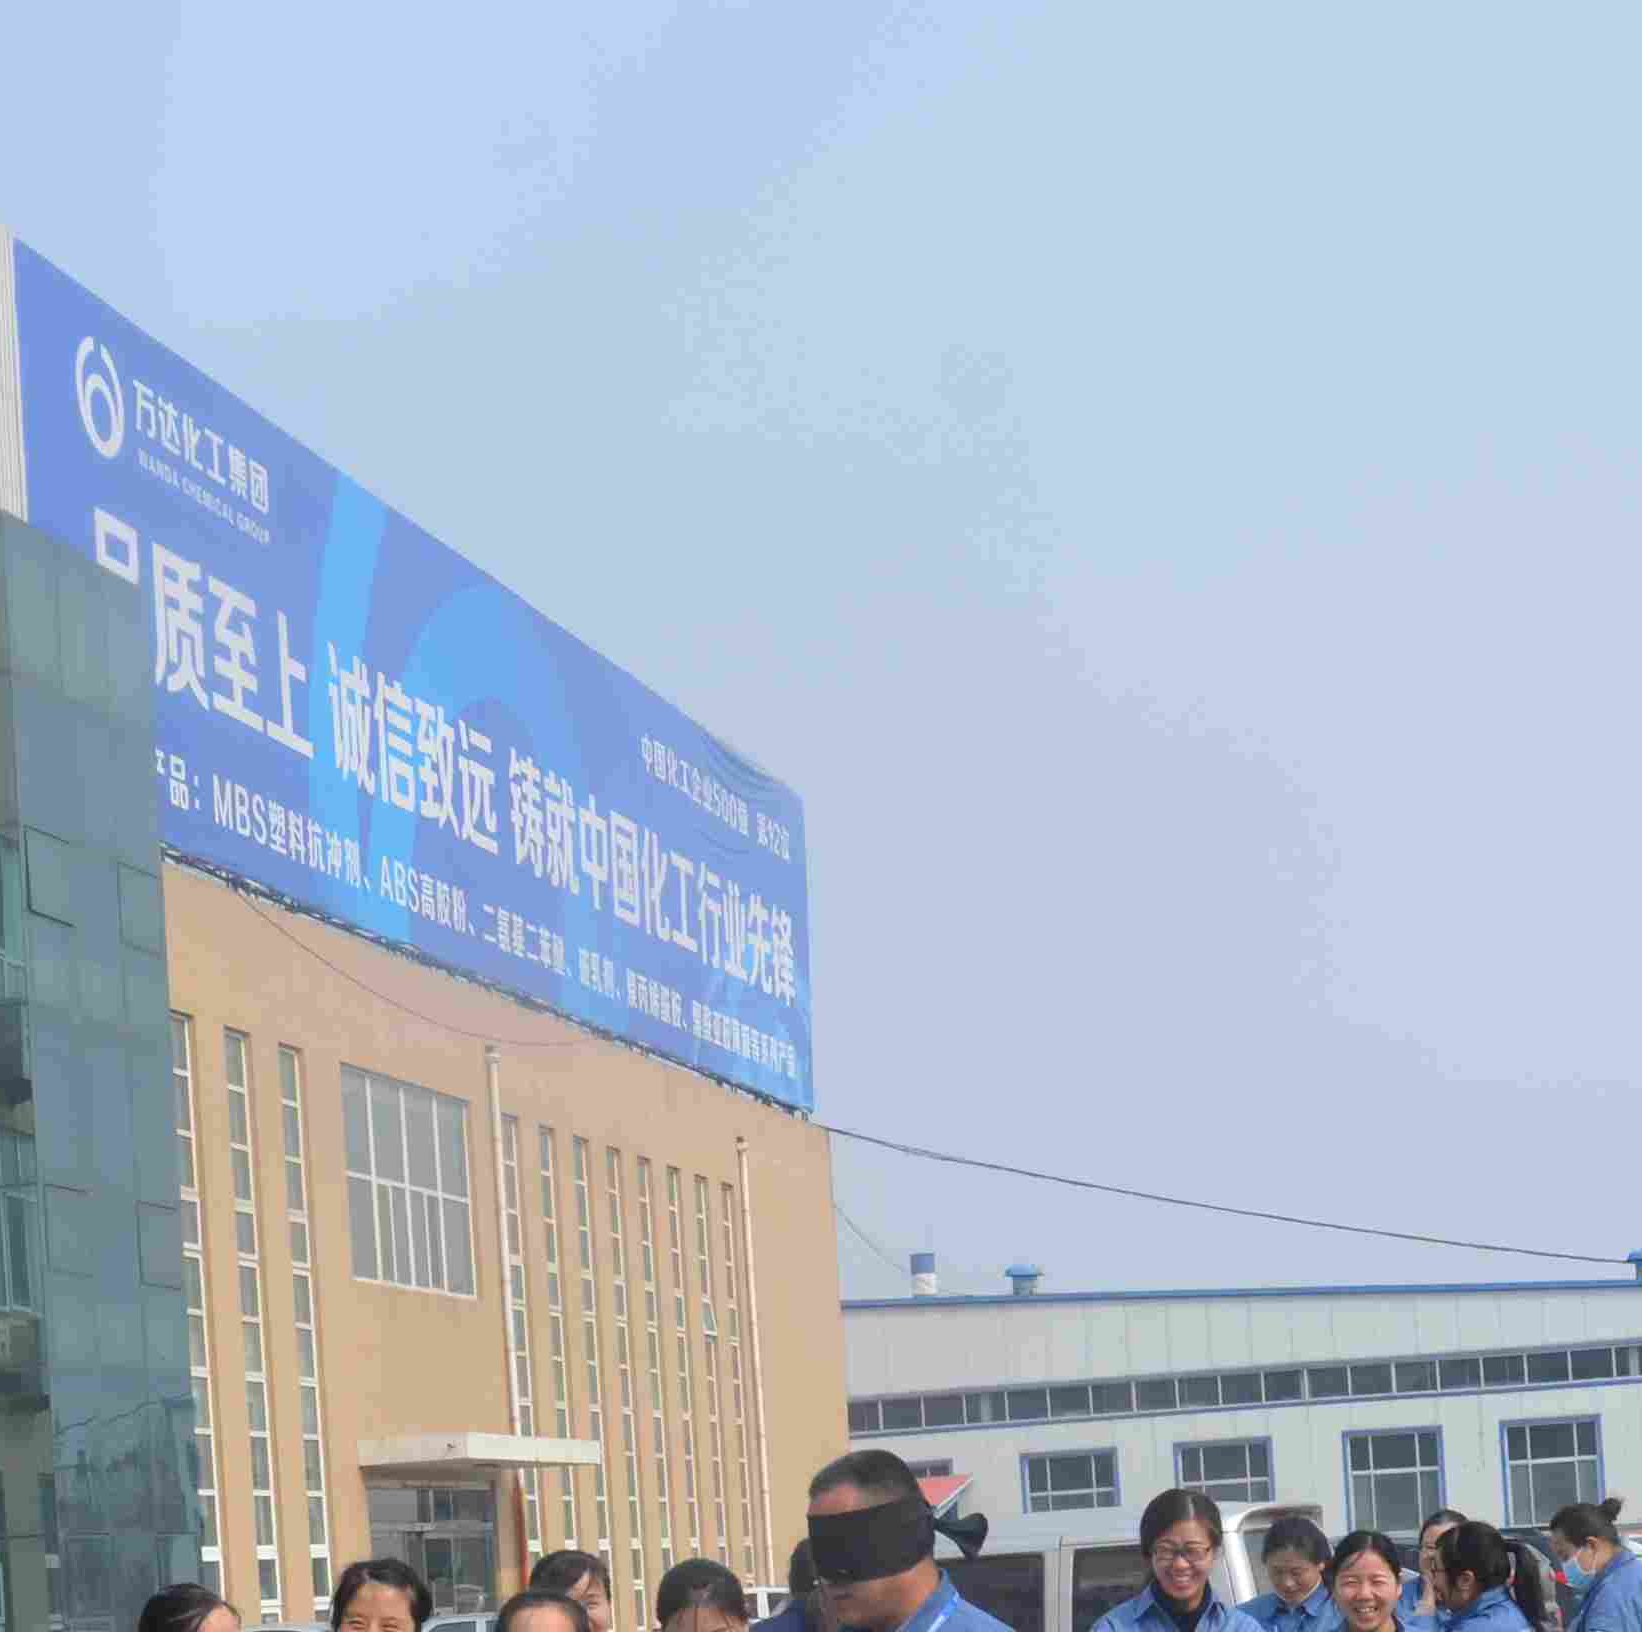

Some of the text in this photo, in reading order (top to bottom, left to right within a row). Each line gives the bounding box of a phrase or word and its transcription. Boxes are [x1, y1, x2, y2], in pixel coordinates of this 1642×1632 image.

[326, 640, 499, 855] 诚信致远
[508, 746, 797, 1008] 铸就中国化工行业先锋
